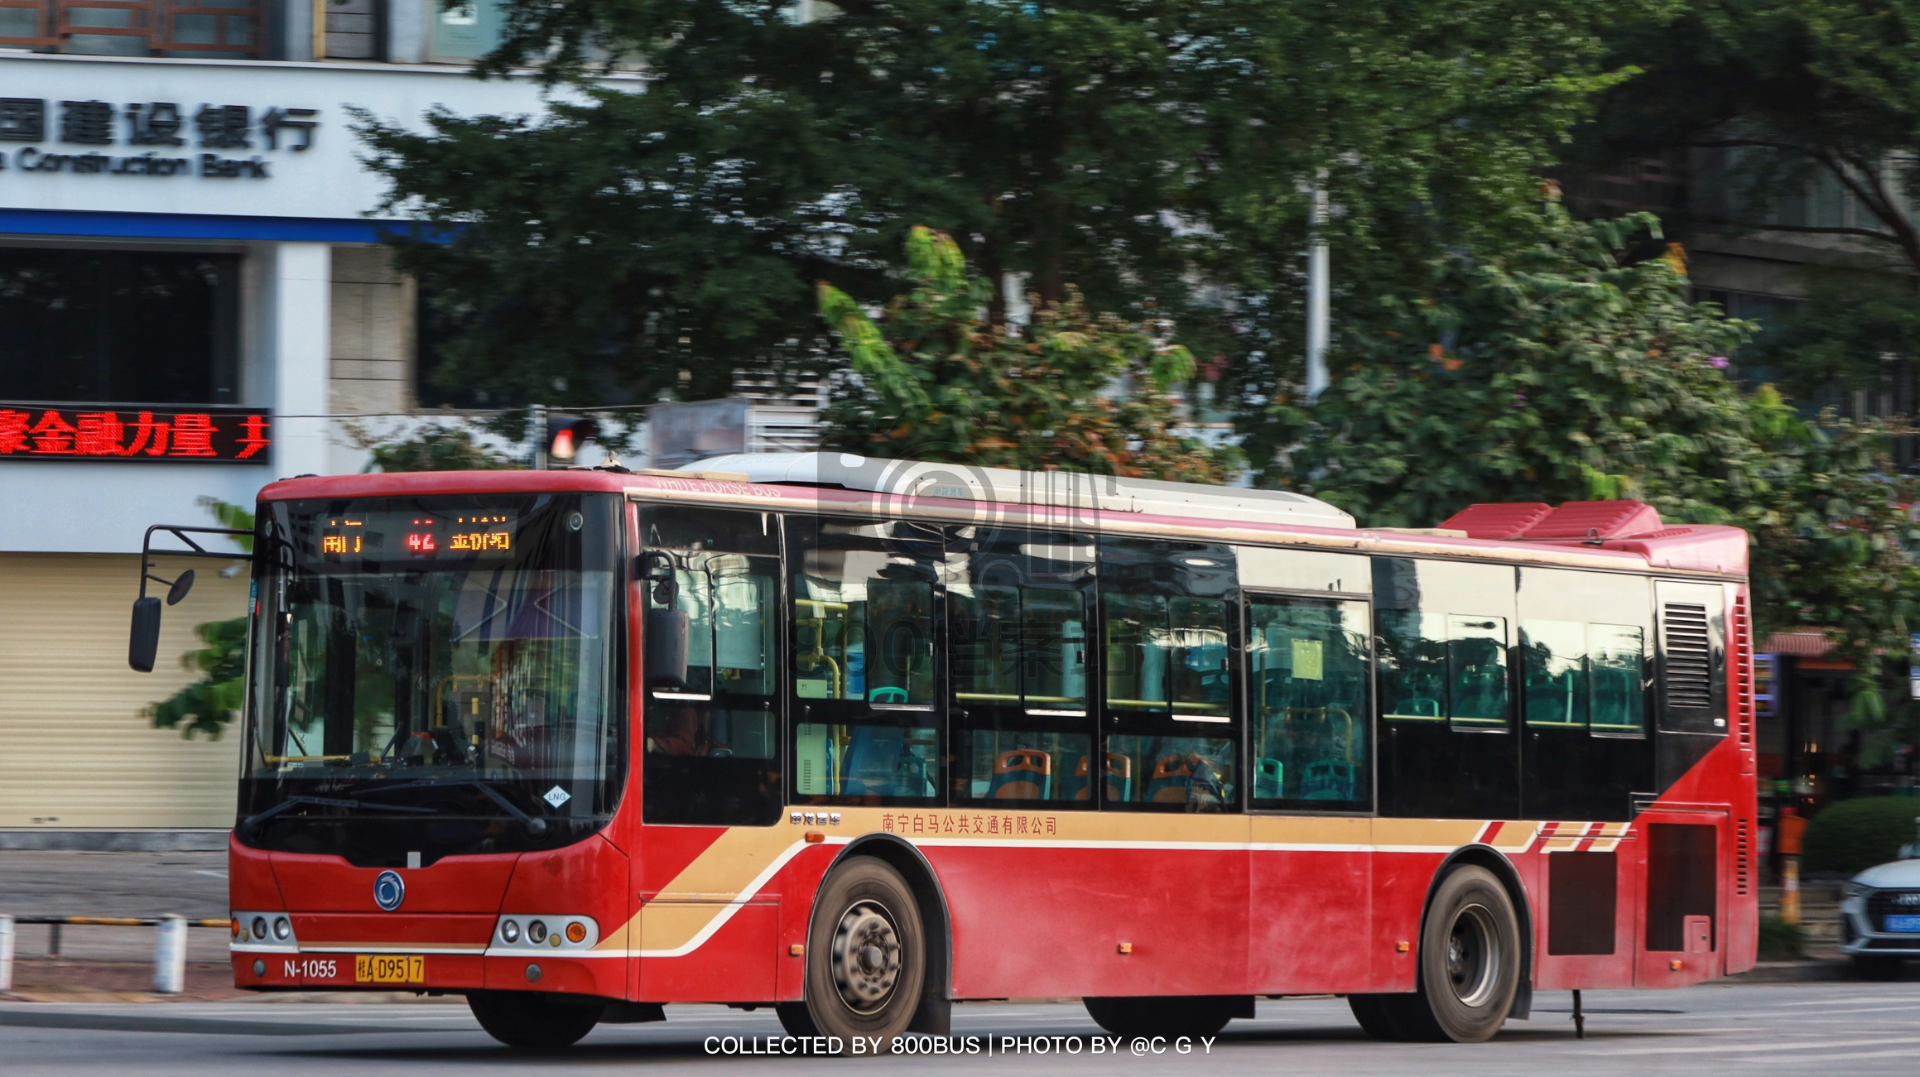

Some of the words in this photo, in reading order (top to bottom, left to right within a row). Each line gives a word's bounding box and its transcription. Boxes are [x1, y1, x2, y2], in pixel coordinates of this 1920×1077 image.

[0, 97, 321, 151] 国建设银行
[17, 147, 192, 175] Construction
[200, 154, 272, 178] Bank
[653, 477, 700, 491] WHITE
[701, 481, 751, 495] HORSE
[751, 485, 781, 497] BUS
[548, 793, 566, 801] LNG
[882, 813, 1057, 835] 南宁白马公共交通有限公司
[284, 959, 337, 978] N-1055
